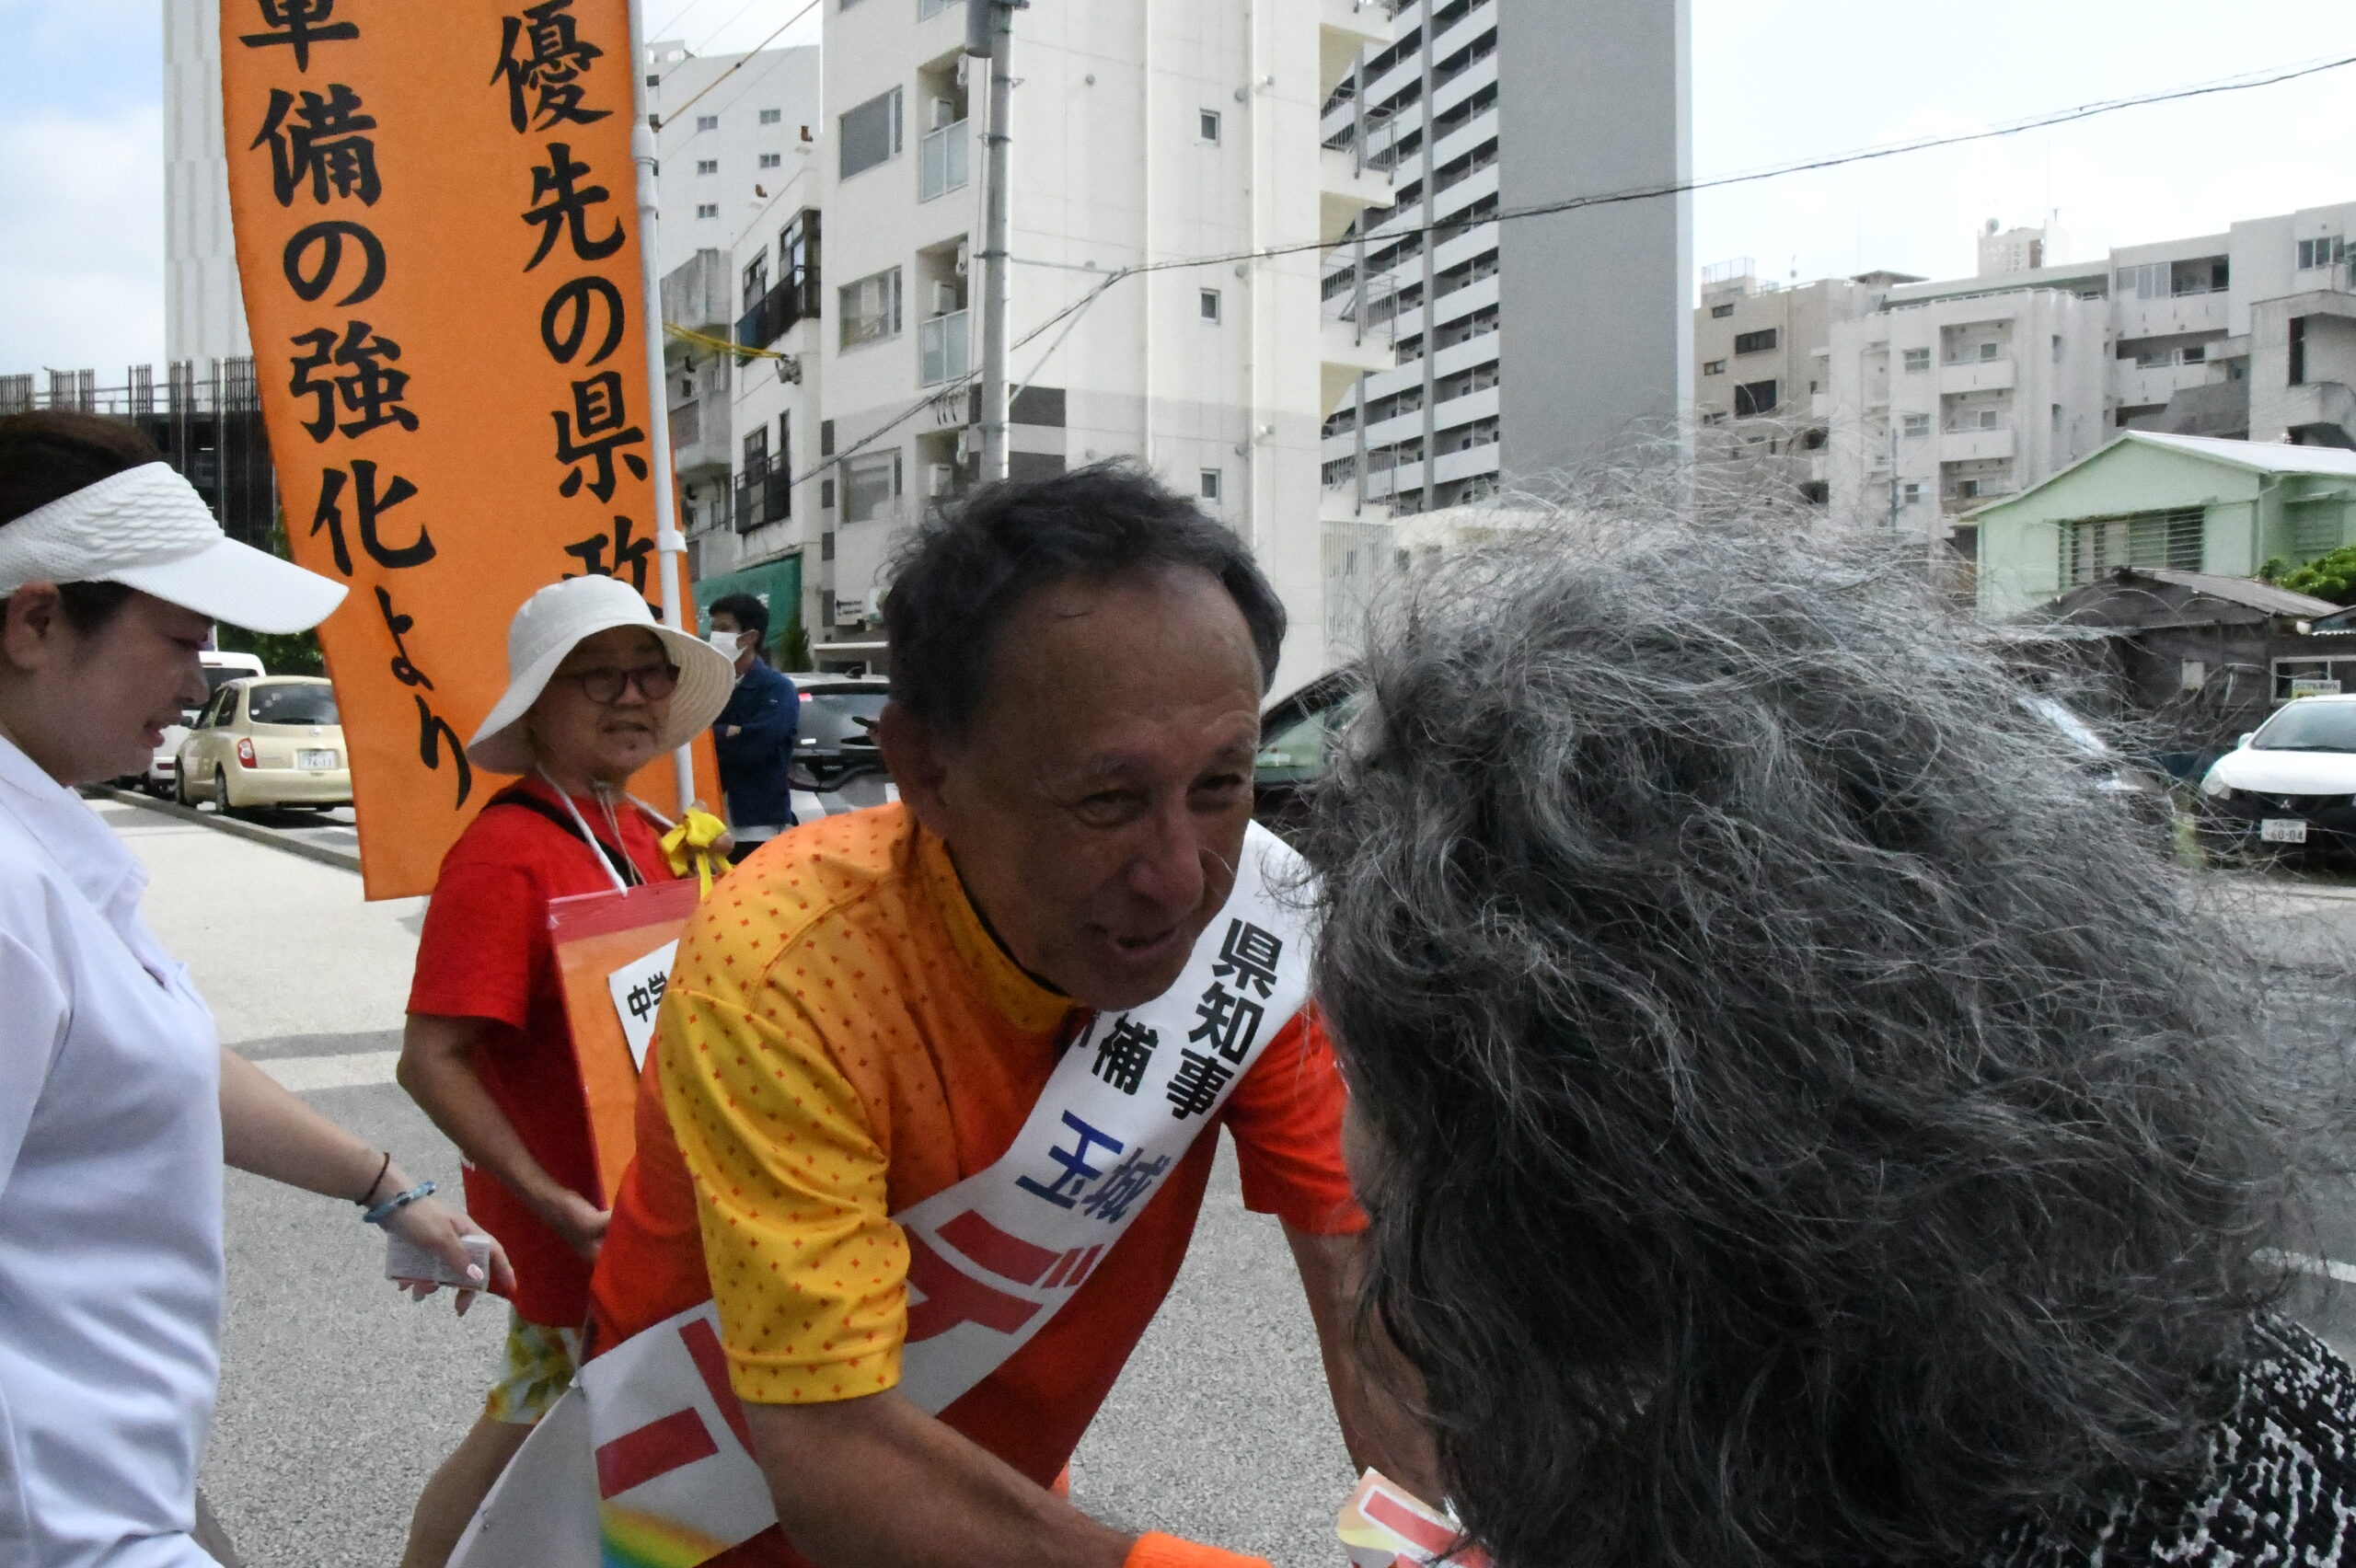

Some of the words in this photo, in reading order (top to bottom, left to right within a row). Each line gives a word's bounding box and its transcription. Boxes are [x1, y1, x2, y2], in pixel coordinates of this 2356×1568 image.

[1078, 1010, 1160, 1096] 補
[1166, 917, 1284, 1121] 県知事
[1014, 1110, 1172, 1225] 玉城
